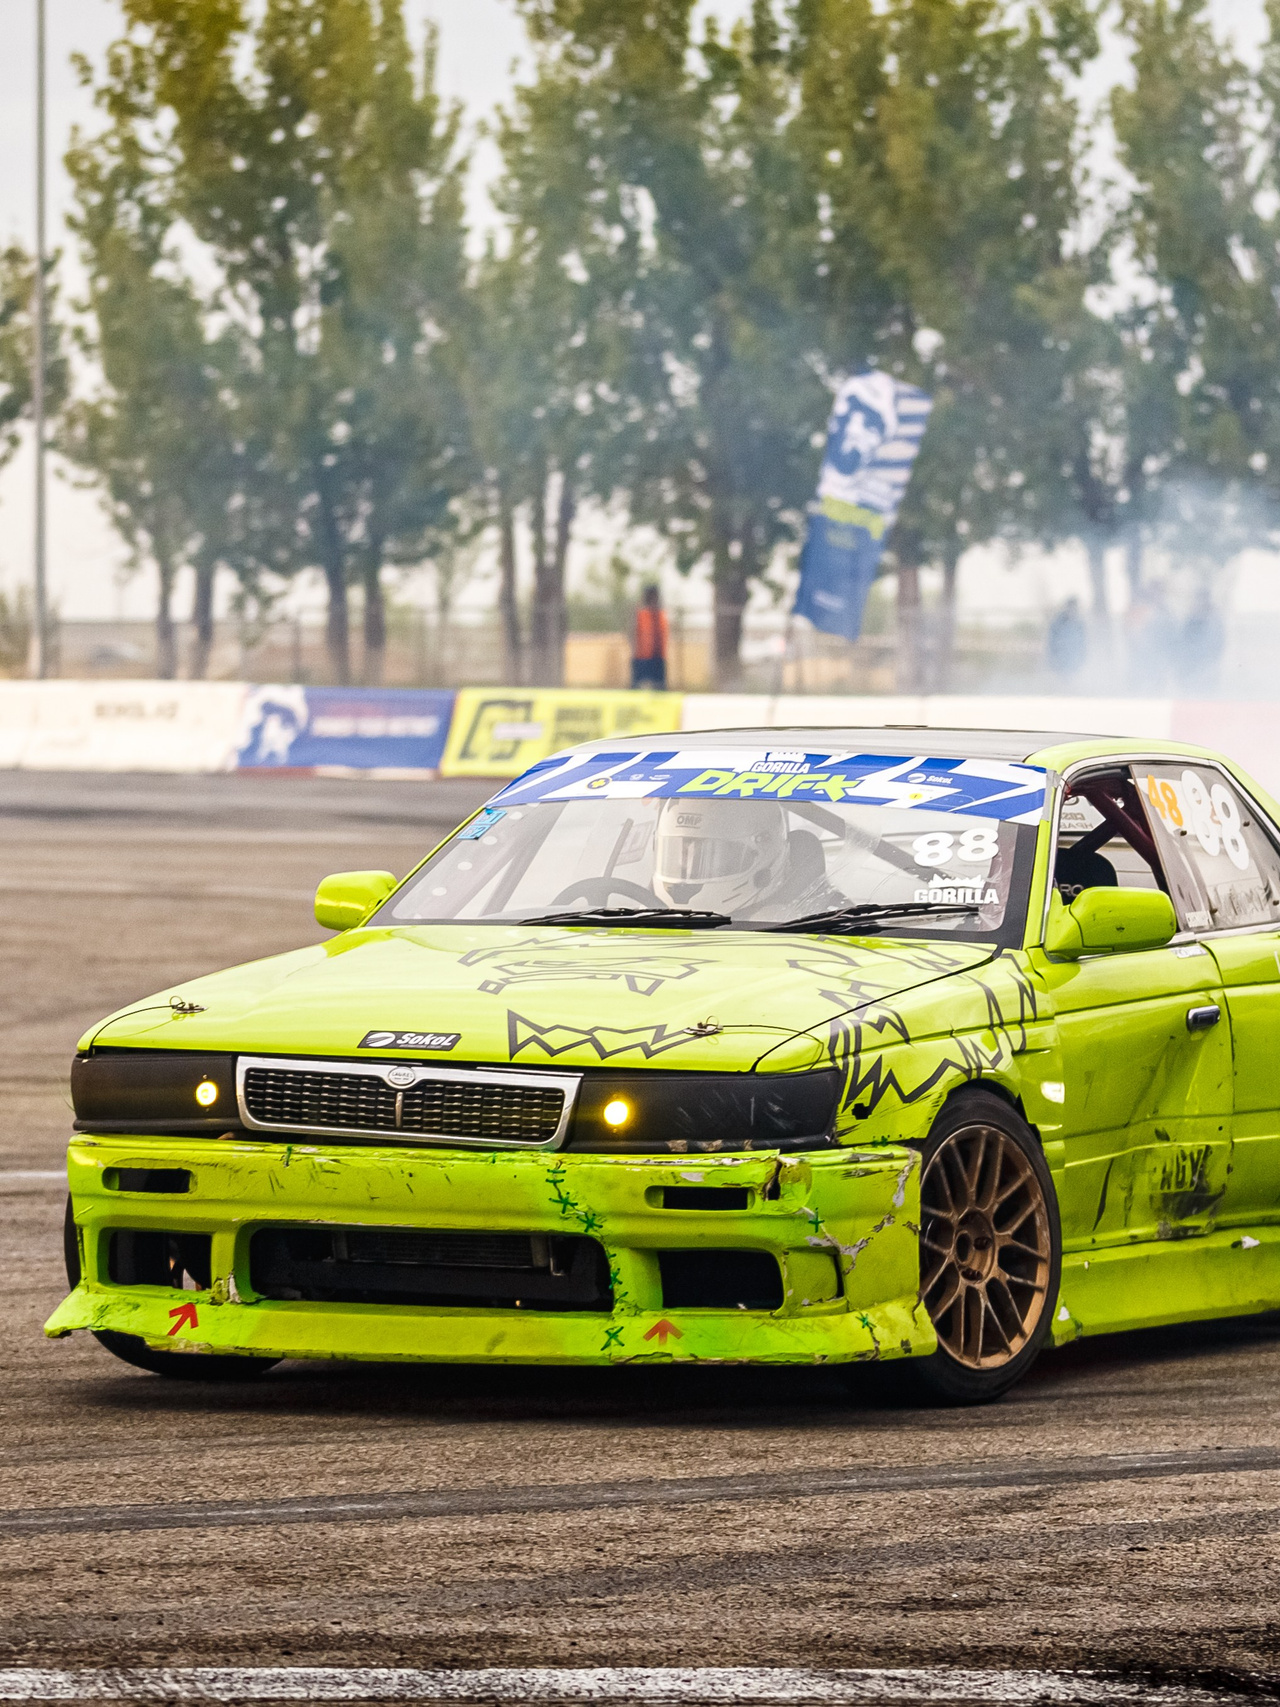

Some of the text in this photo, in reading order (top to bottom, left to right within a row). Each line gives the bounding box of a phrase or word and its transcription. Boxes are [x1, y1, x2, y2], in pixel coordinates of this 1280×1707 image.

[751, 761, 811, 774] GORILLA
[676, 814, 702, 826] OMP
[1181, 769, 1249, 871] 88
[912, 827, 999, 867] 88
[914, 888, 1000, 904] GORILLA
